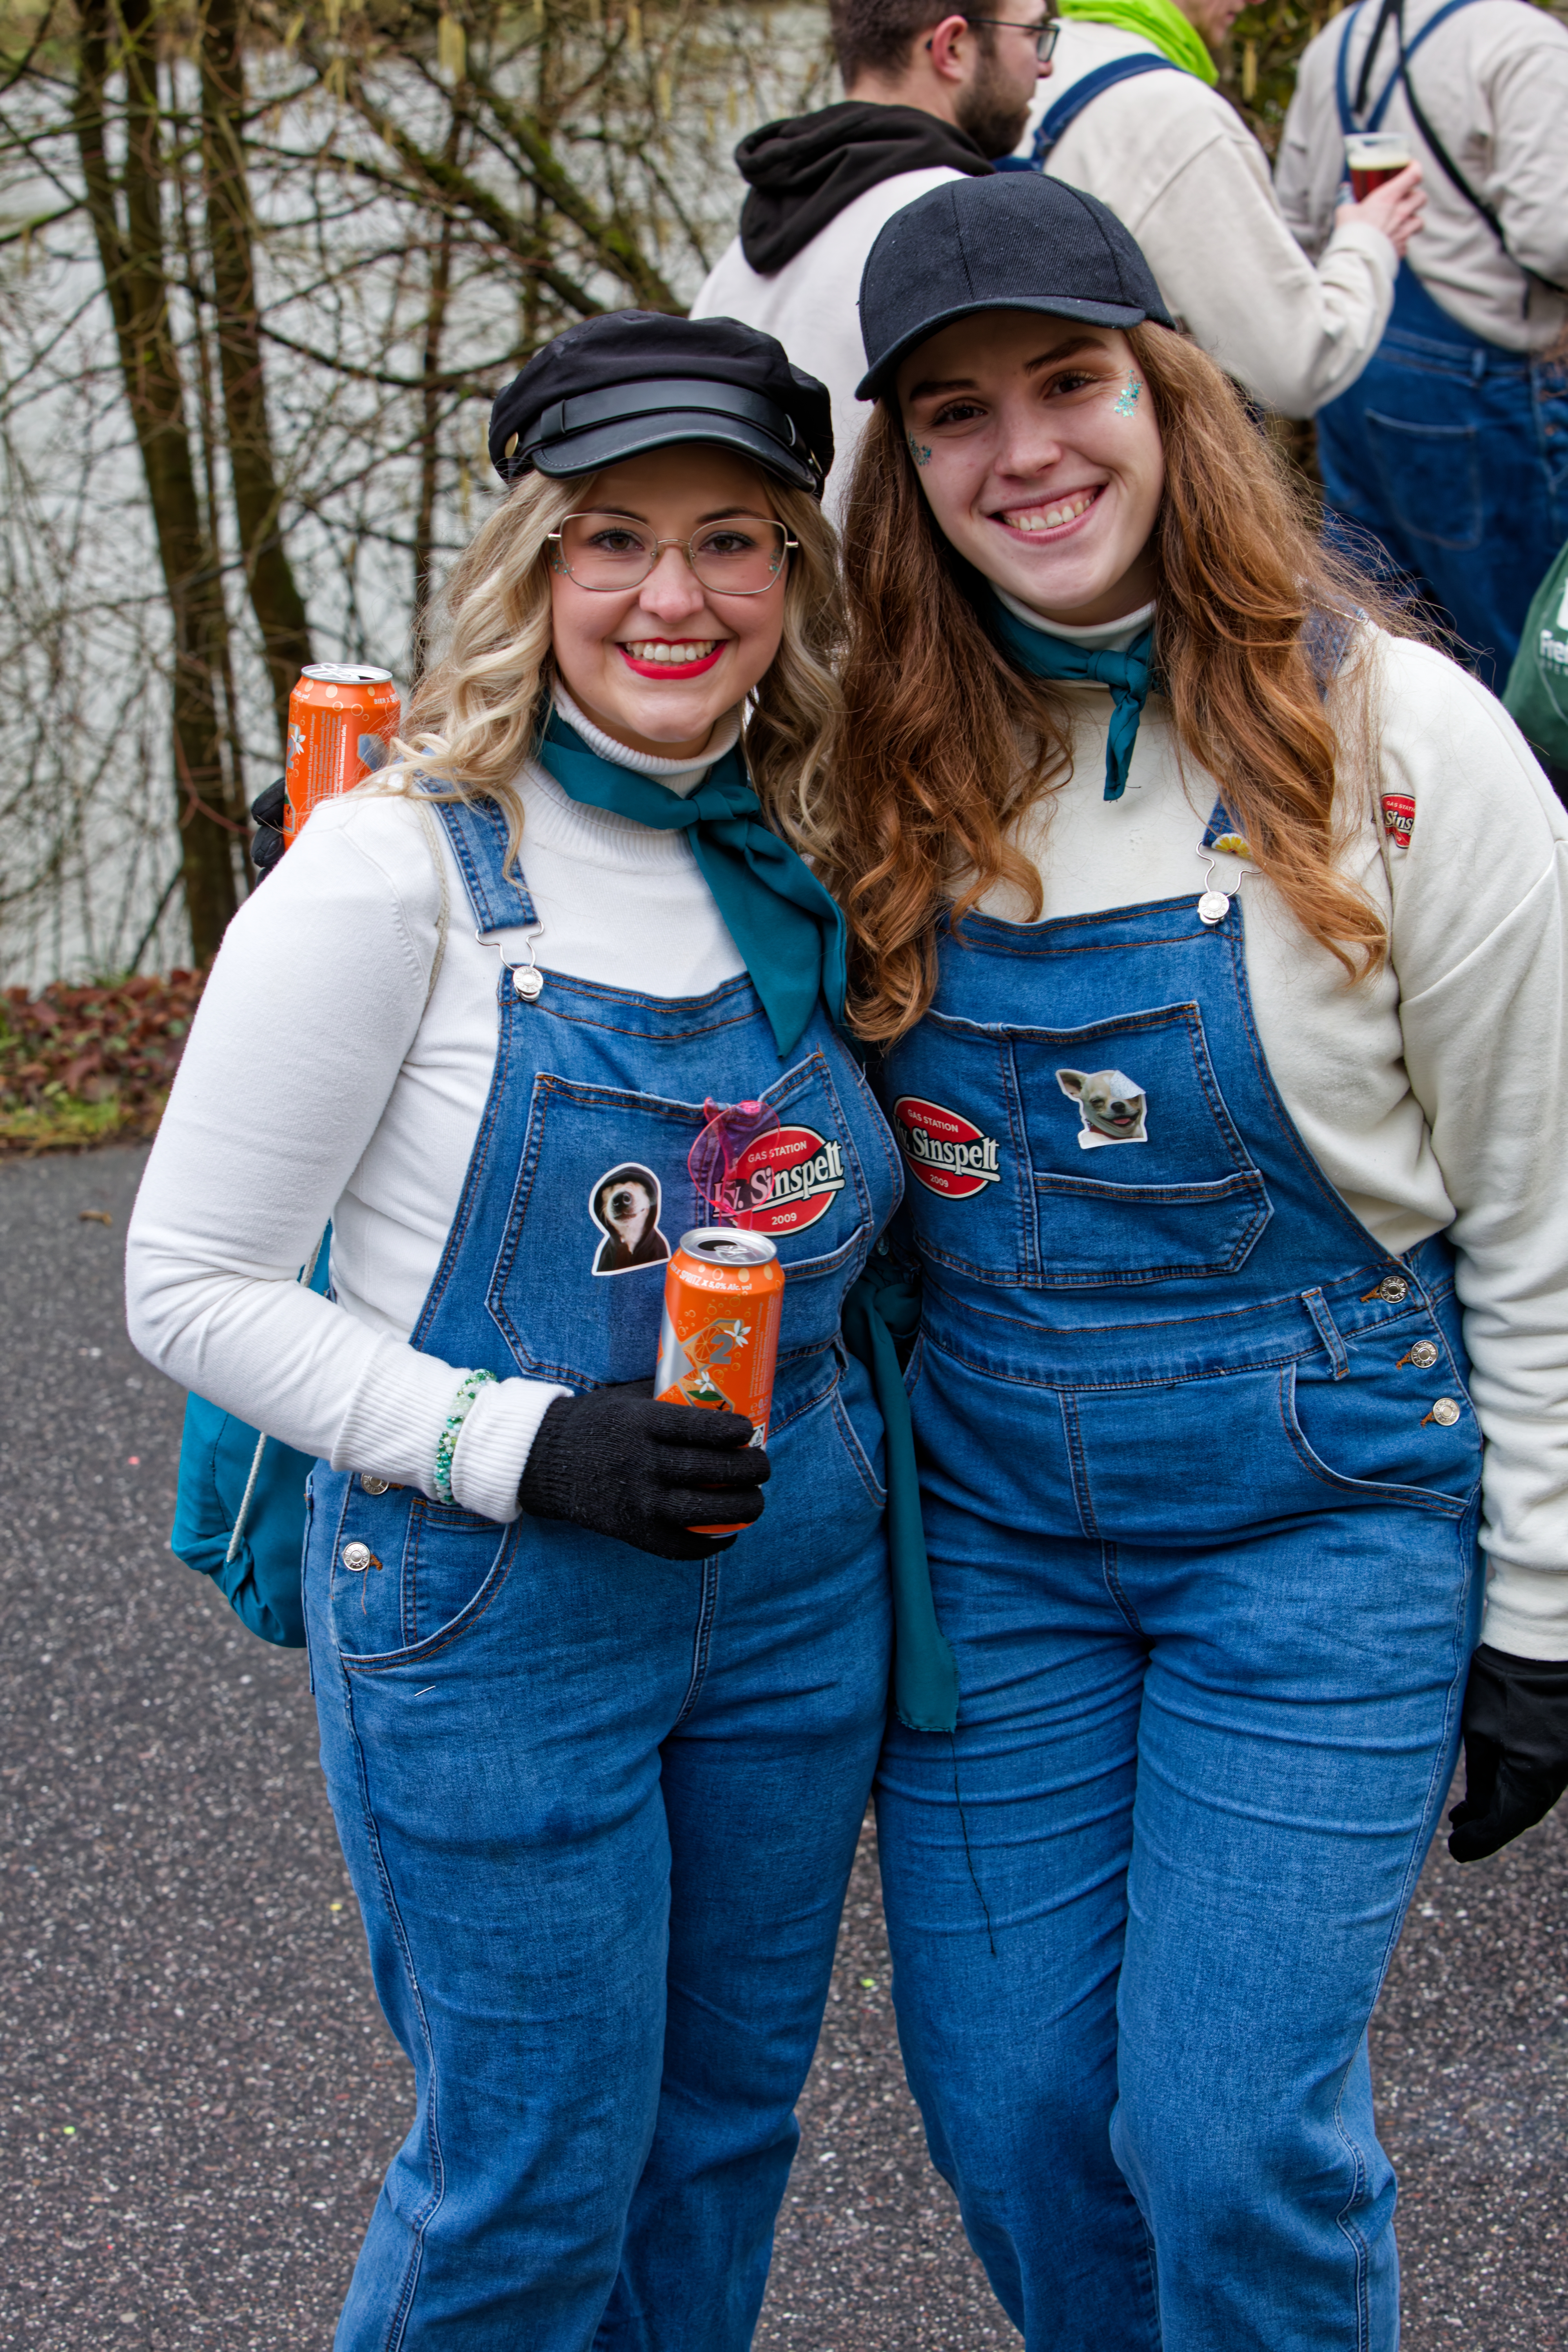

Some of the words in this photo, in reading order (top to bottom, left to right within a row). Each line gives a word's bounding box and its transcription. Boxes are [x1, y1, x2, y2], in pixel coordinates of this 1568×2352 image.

[1399, 804, 1416, 813] STATI
[1385, 810, 1414, 831] Sins
[908, 1109, 922, 1122] GAS
[924, 1116, 959, 1133] STATION
[748, 1151, 767, 1163] GAS
[769, 1140, 807, 1158] STATION
[912, 1127, 1000, 1175] Sinspelt
[750, 1141, 844, 1204] Sinspelt
[930, 1174, 949, 1188] 2009
[771, 1212, 797, 1225] 2009
[679, 1270, 702, 1286] SPRITZ
[708, 1281, 726, 1290] 5,0%
[709, 1334, 733, 1365] 2
